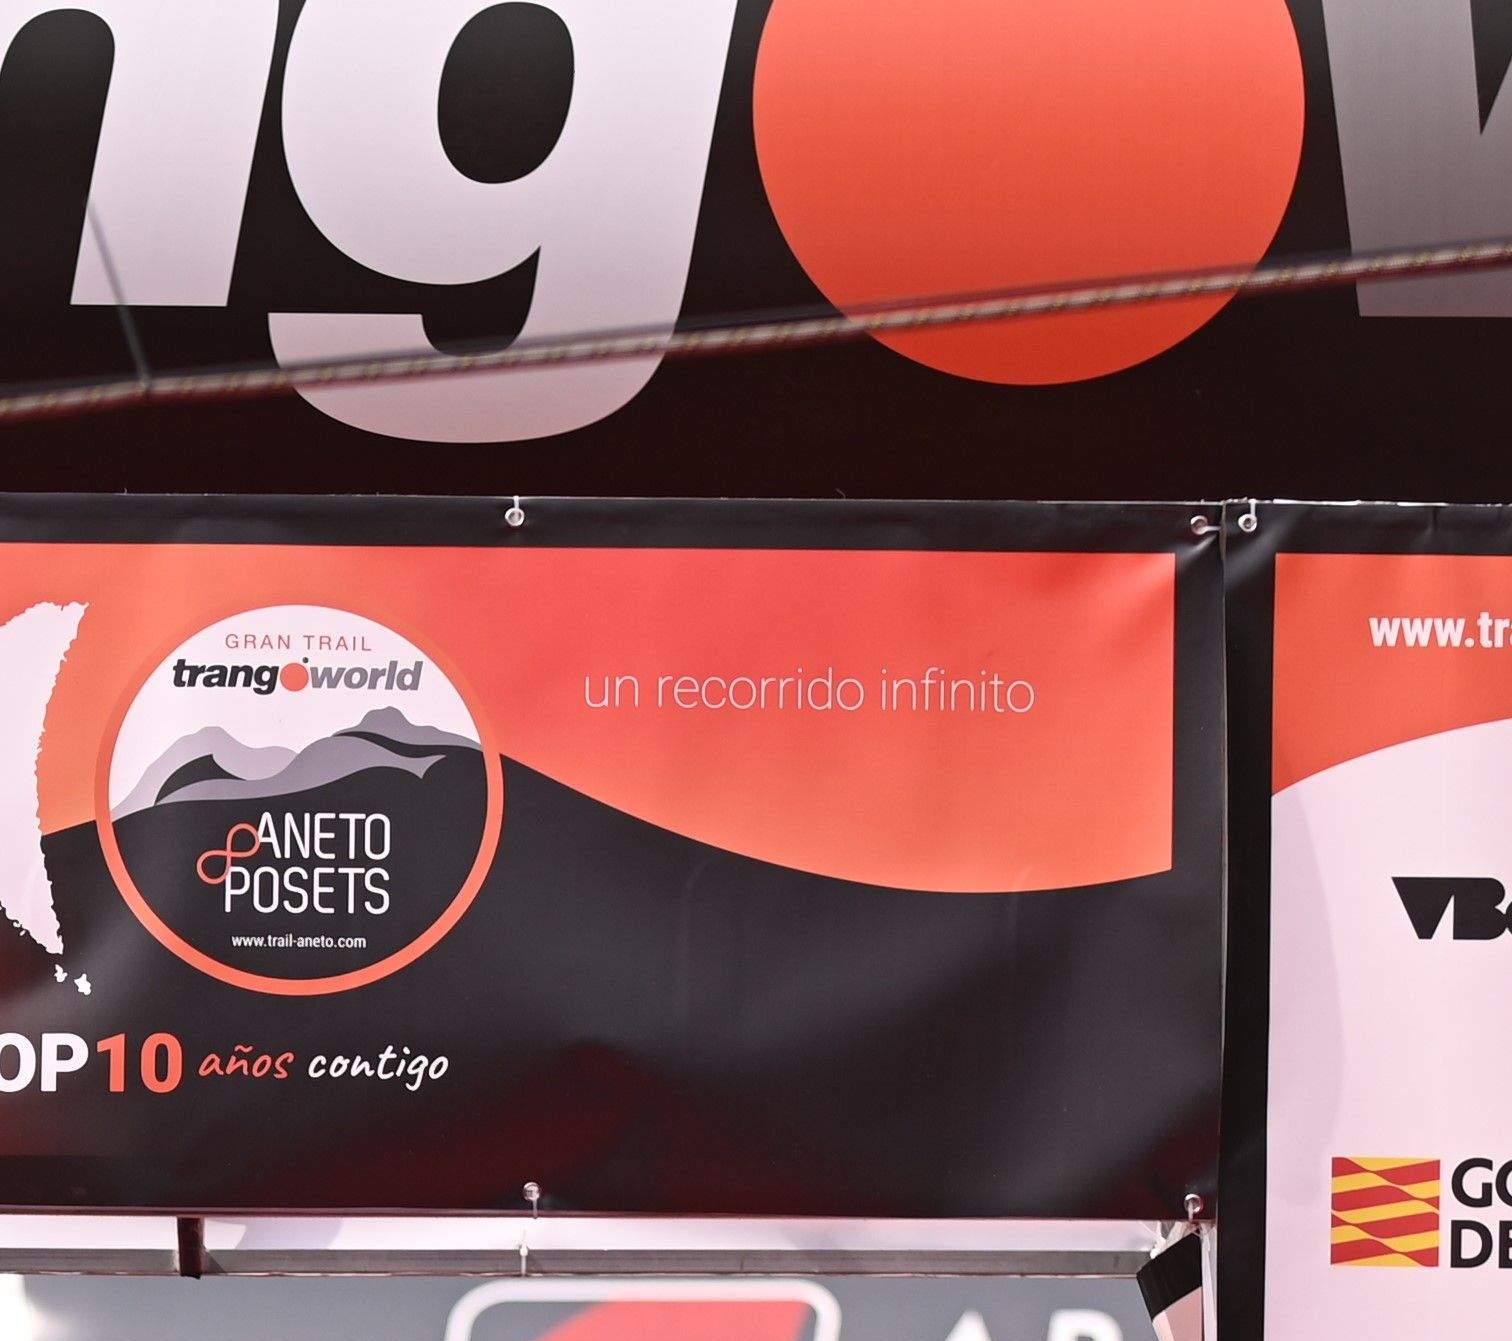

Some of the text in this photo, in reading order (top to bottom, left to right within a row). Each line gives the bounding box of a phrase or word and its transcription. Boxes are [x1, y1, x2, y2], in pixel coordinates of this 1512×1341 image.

[224, 633, 371, 651] GRAN TRAIL
[172, 655, 422, 695] trangoworld
[584, 666, 1035, 715] un recorrido infinito
[256, 811, 390, 862] ANETO
[224, 865, 390, 915] POSETS
[231, 932, 367, 950] www.trail-aneto.com
[198, 1044, 294, 1079] años
[307, 1042, 449, 1090] contigo
